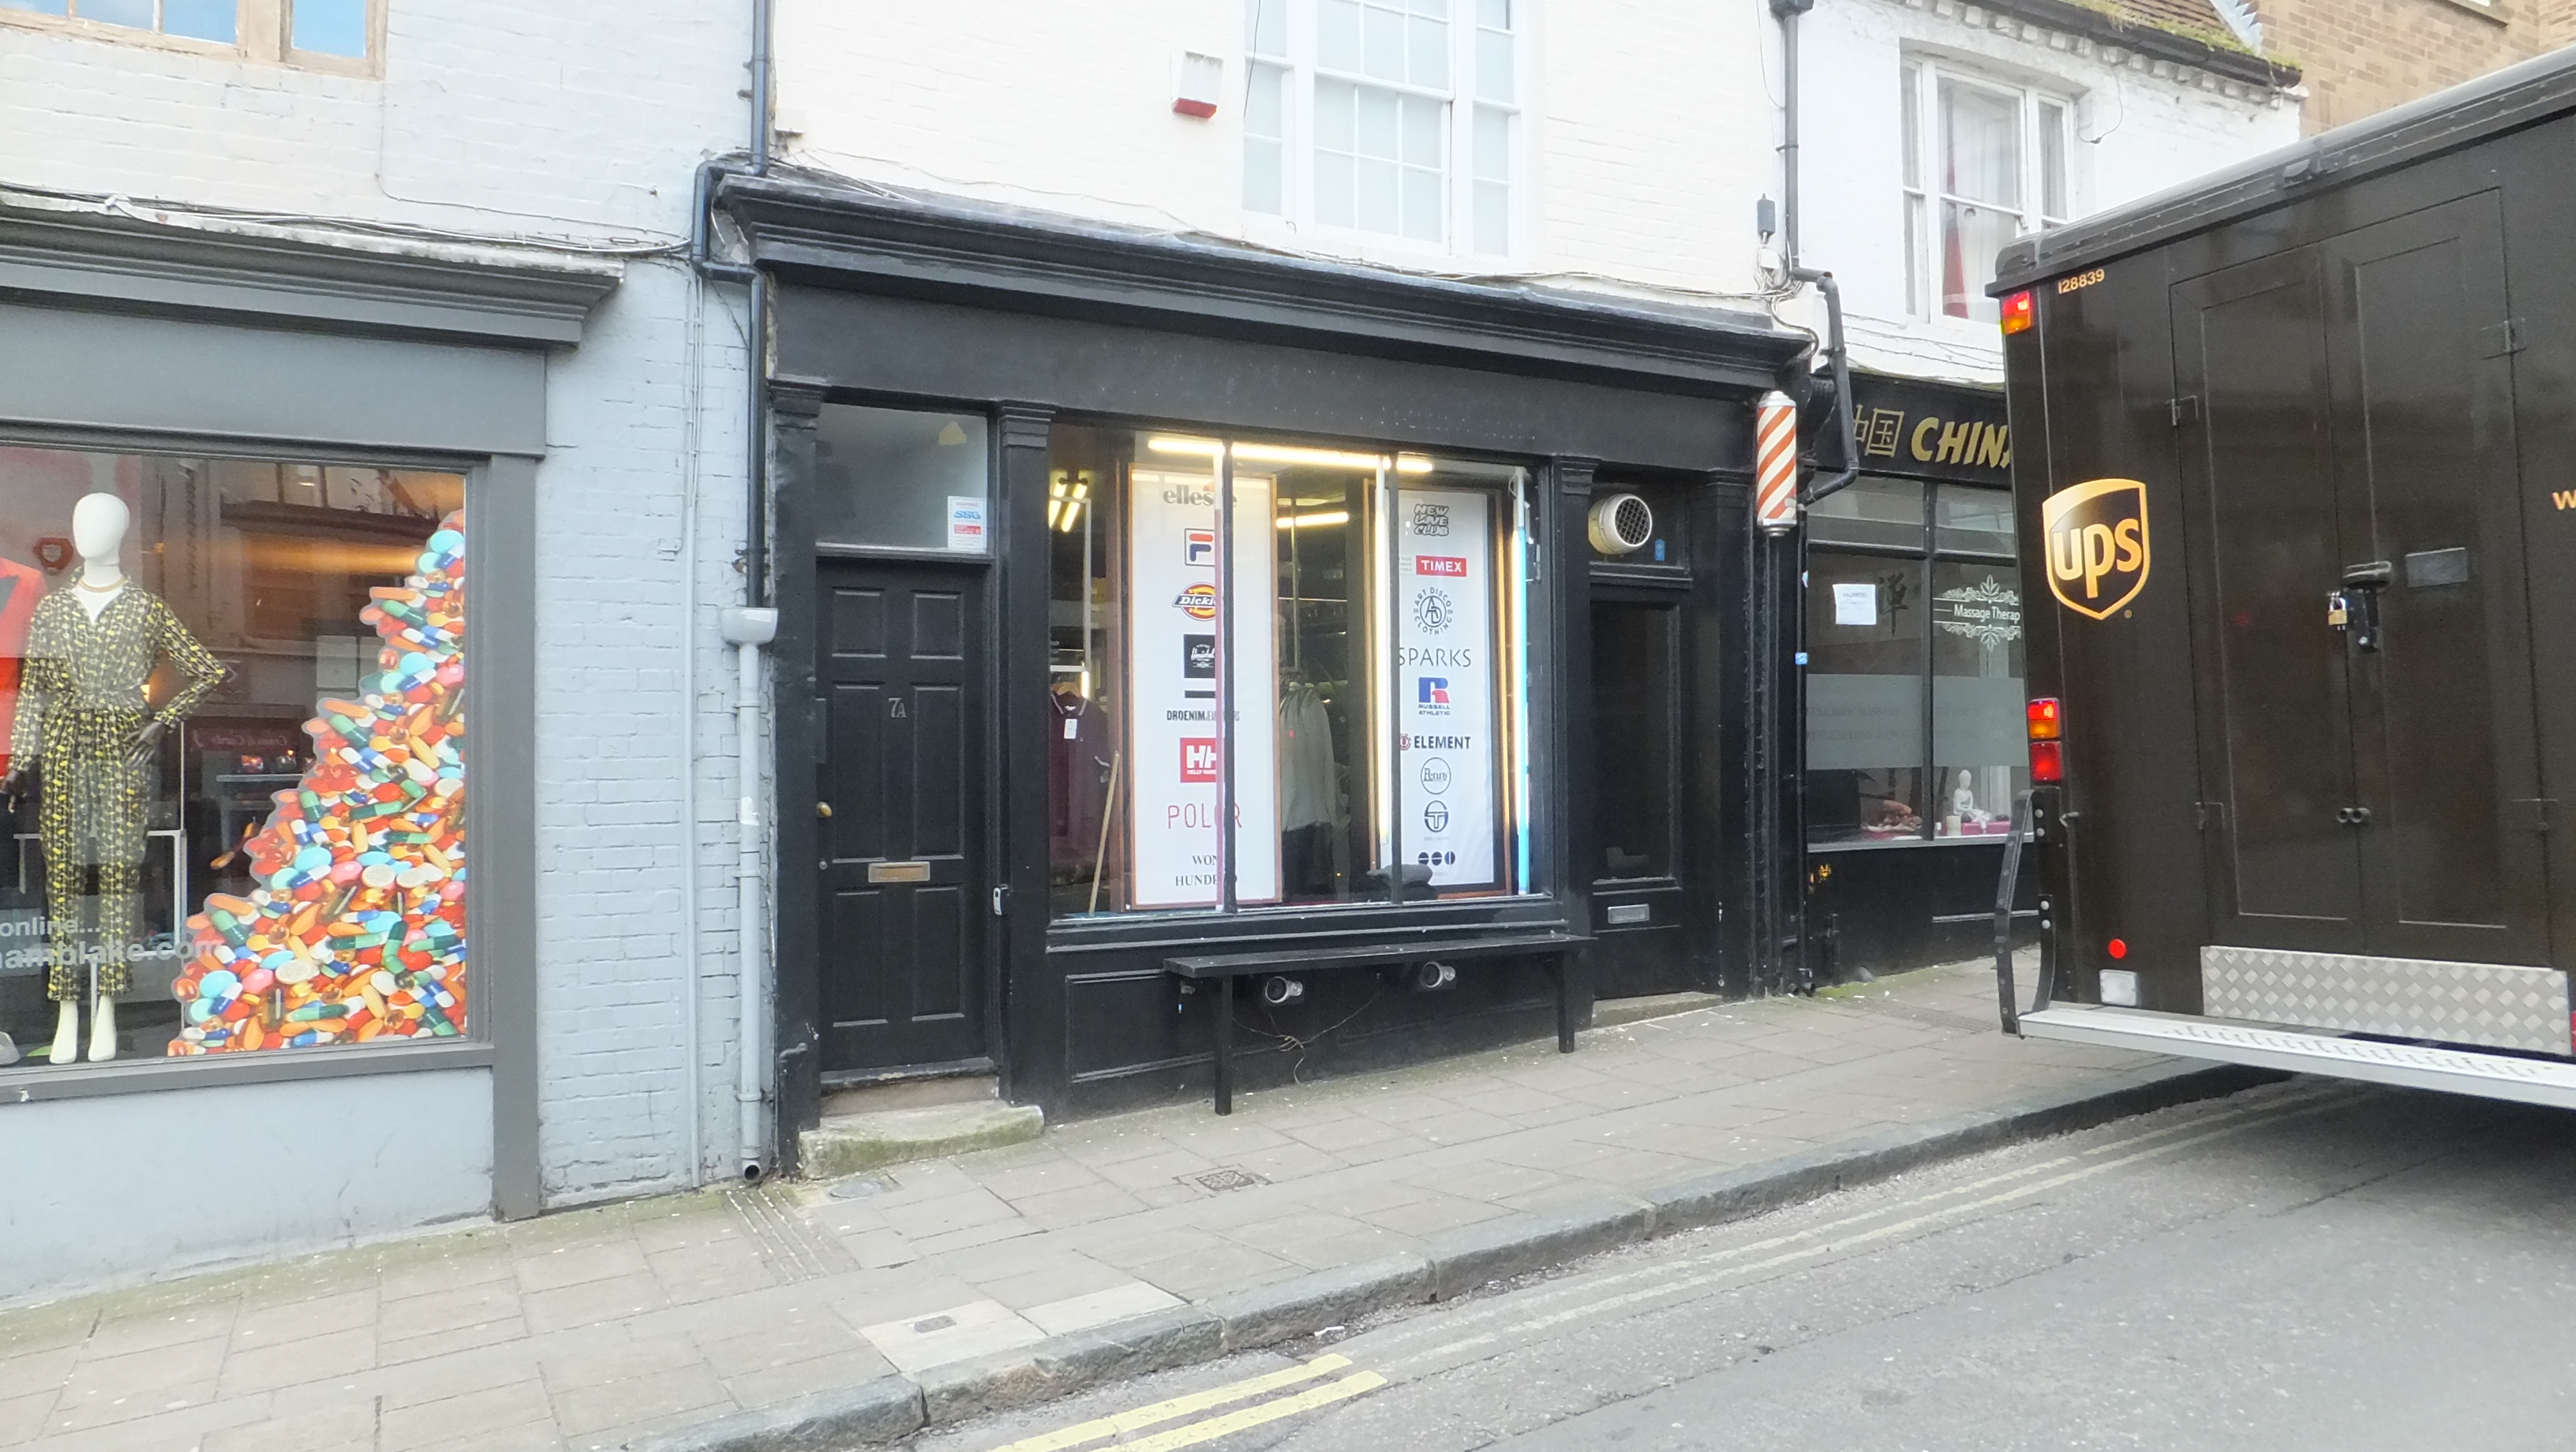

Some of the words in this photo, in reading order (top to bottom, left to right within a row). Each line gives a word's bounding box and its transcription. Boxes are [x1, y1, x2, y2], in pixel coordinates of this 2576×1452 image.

[2057, 268, 2105, 294] 128839
[1911, 417, 2011, 469] CHIN
[1163, 485, 1237, 508] elles
[1413, 503, 1450, 517] NEW
[1413, 524, 1450, 536] CLUB
[1421, 559, 1462, 573] TIMEX
[1178, 596, 1216, 606] Dicki
[1414, 589, 1427, 606] ART
[1429, 586, 1452, 607] DISCO
[1953, 604, 1990, 623] Massage
[1414, 616, 1453, 635] CLOTHING
[1399, 647, 1471, 668] SPARKS
[888, 697, 907, 718] 7A
[1413, 735, 1471, 750] ELEMENT
[1167, 803, 1243, 829] POLR
[0, 937, 225, 970] amblake.com
